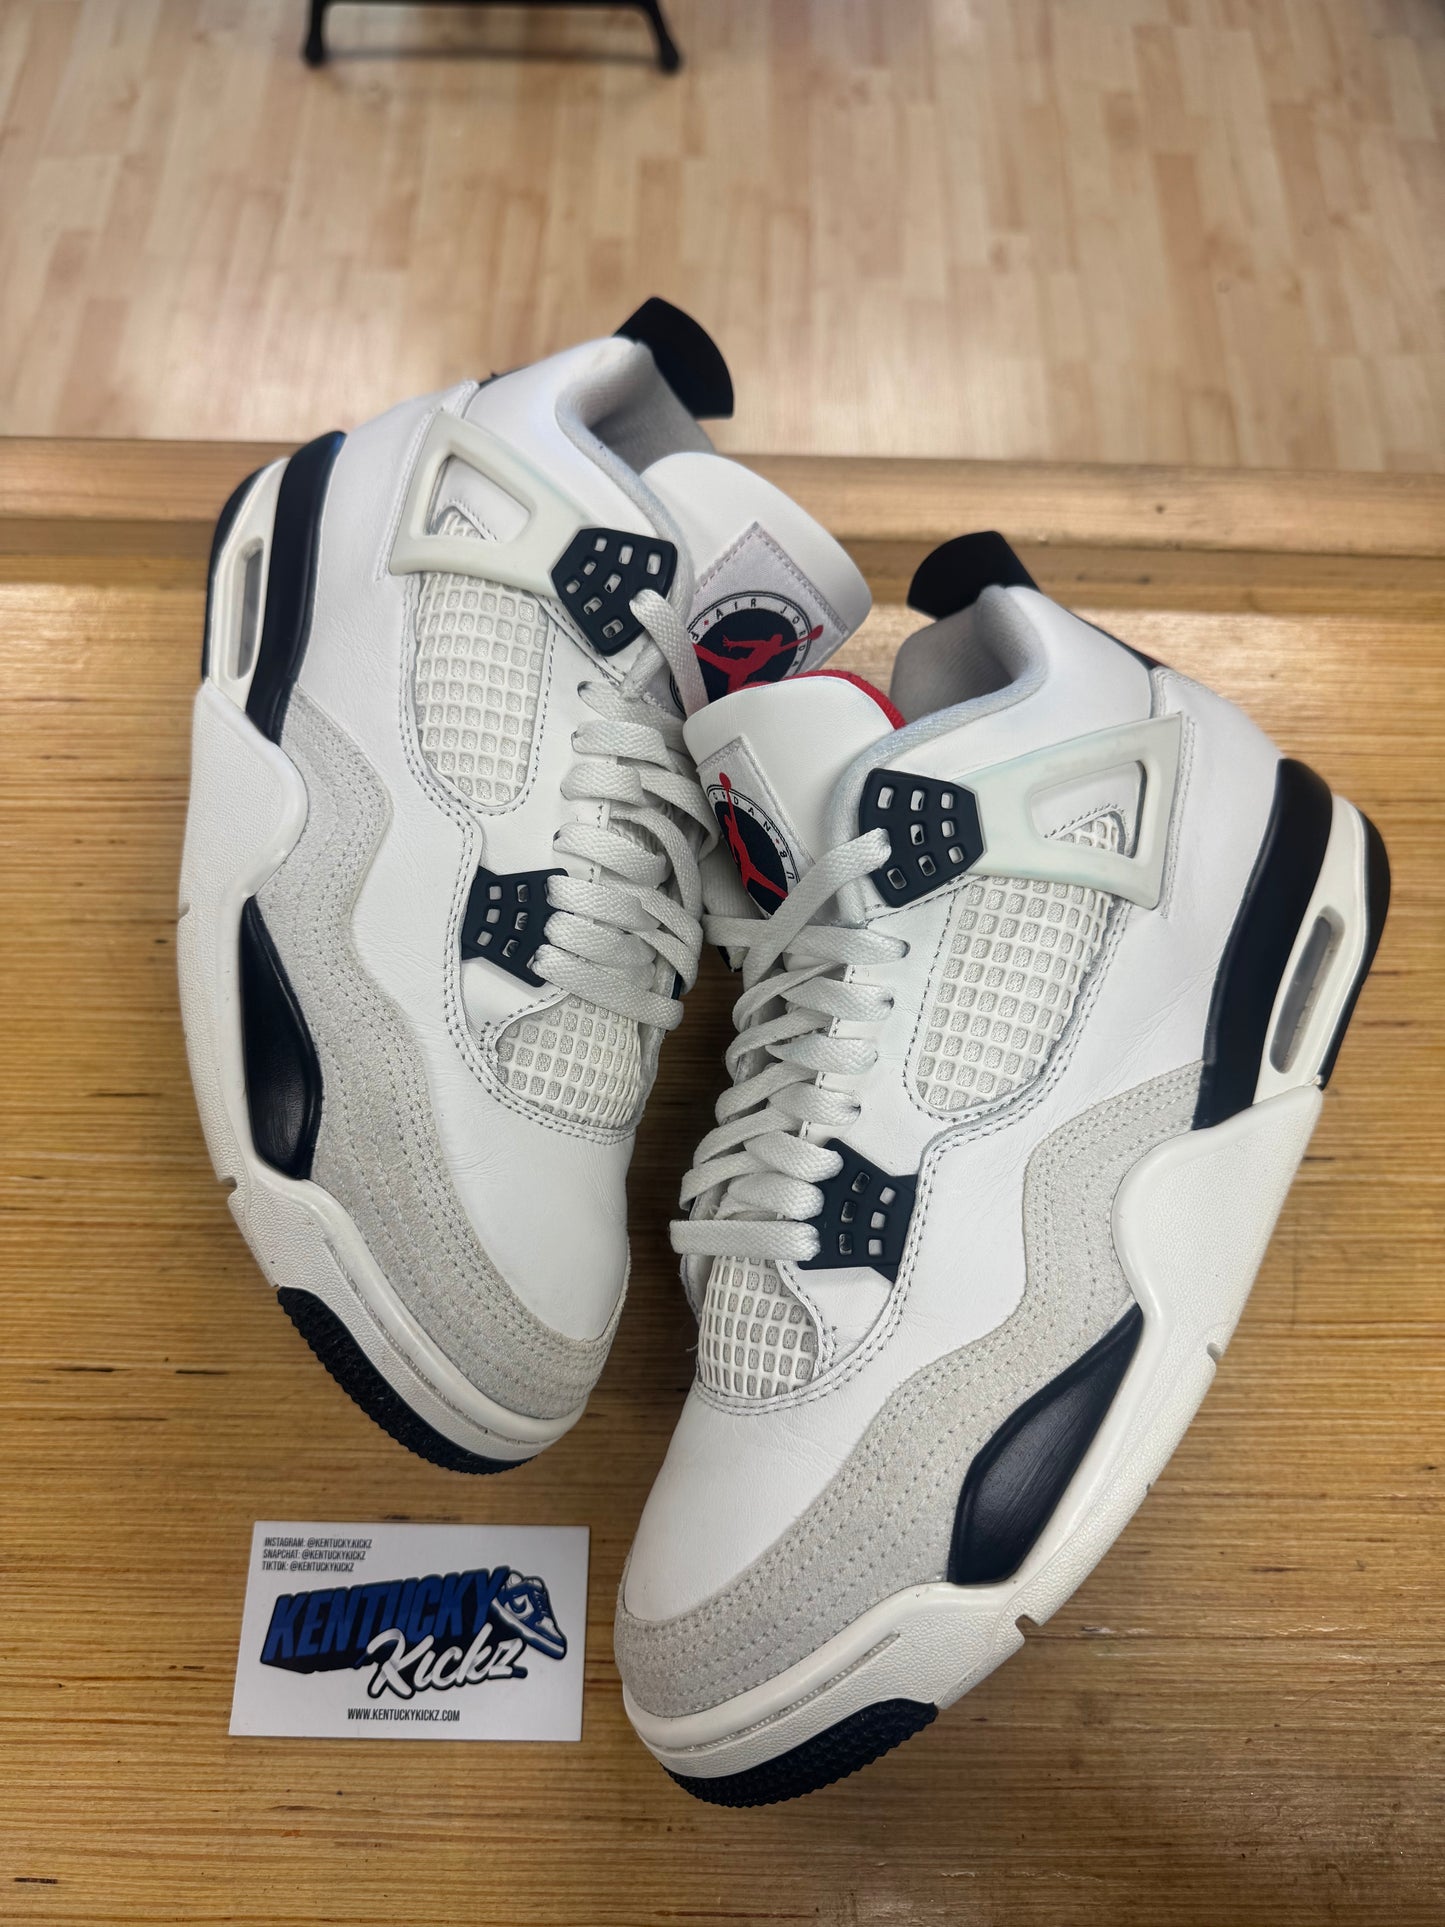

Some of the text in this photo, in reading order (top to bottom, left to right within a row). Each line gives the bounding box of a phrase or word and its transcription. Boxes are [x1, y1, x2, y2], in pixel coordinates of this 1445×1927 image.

[715, 598, 757, 620] AIR
[264, 1537, 305, 1547] INSTAGRAM:
[263, 1549, 366, 1560] SNAPCHAT: @KENTUCKYKICKZ
[262, 1560, 355, 1572] TIKTOK: @KENTUCKYKICKZ
[261, 1566, 510, 1665] KENTUCKY
[367, 1623, 525, 1697] Kickz
[347, 1708, 460, 1721] WWW.KENTUCKYKICKZ.COM
